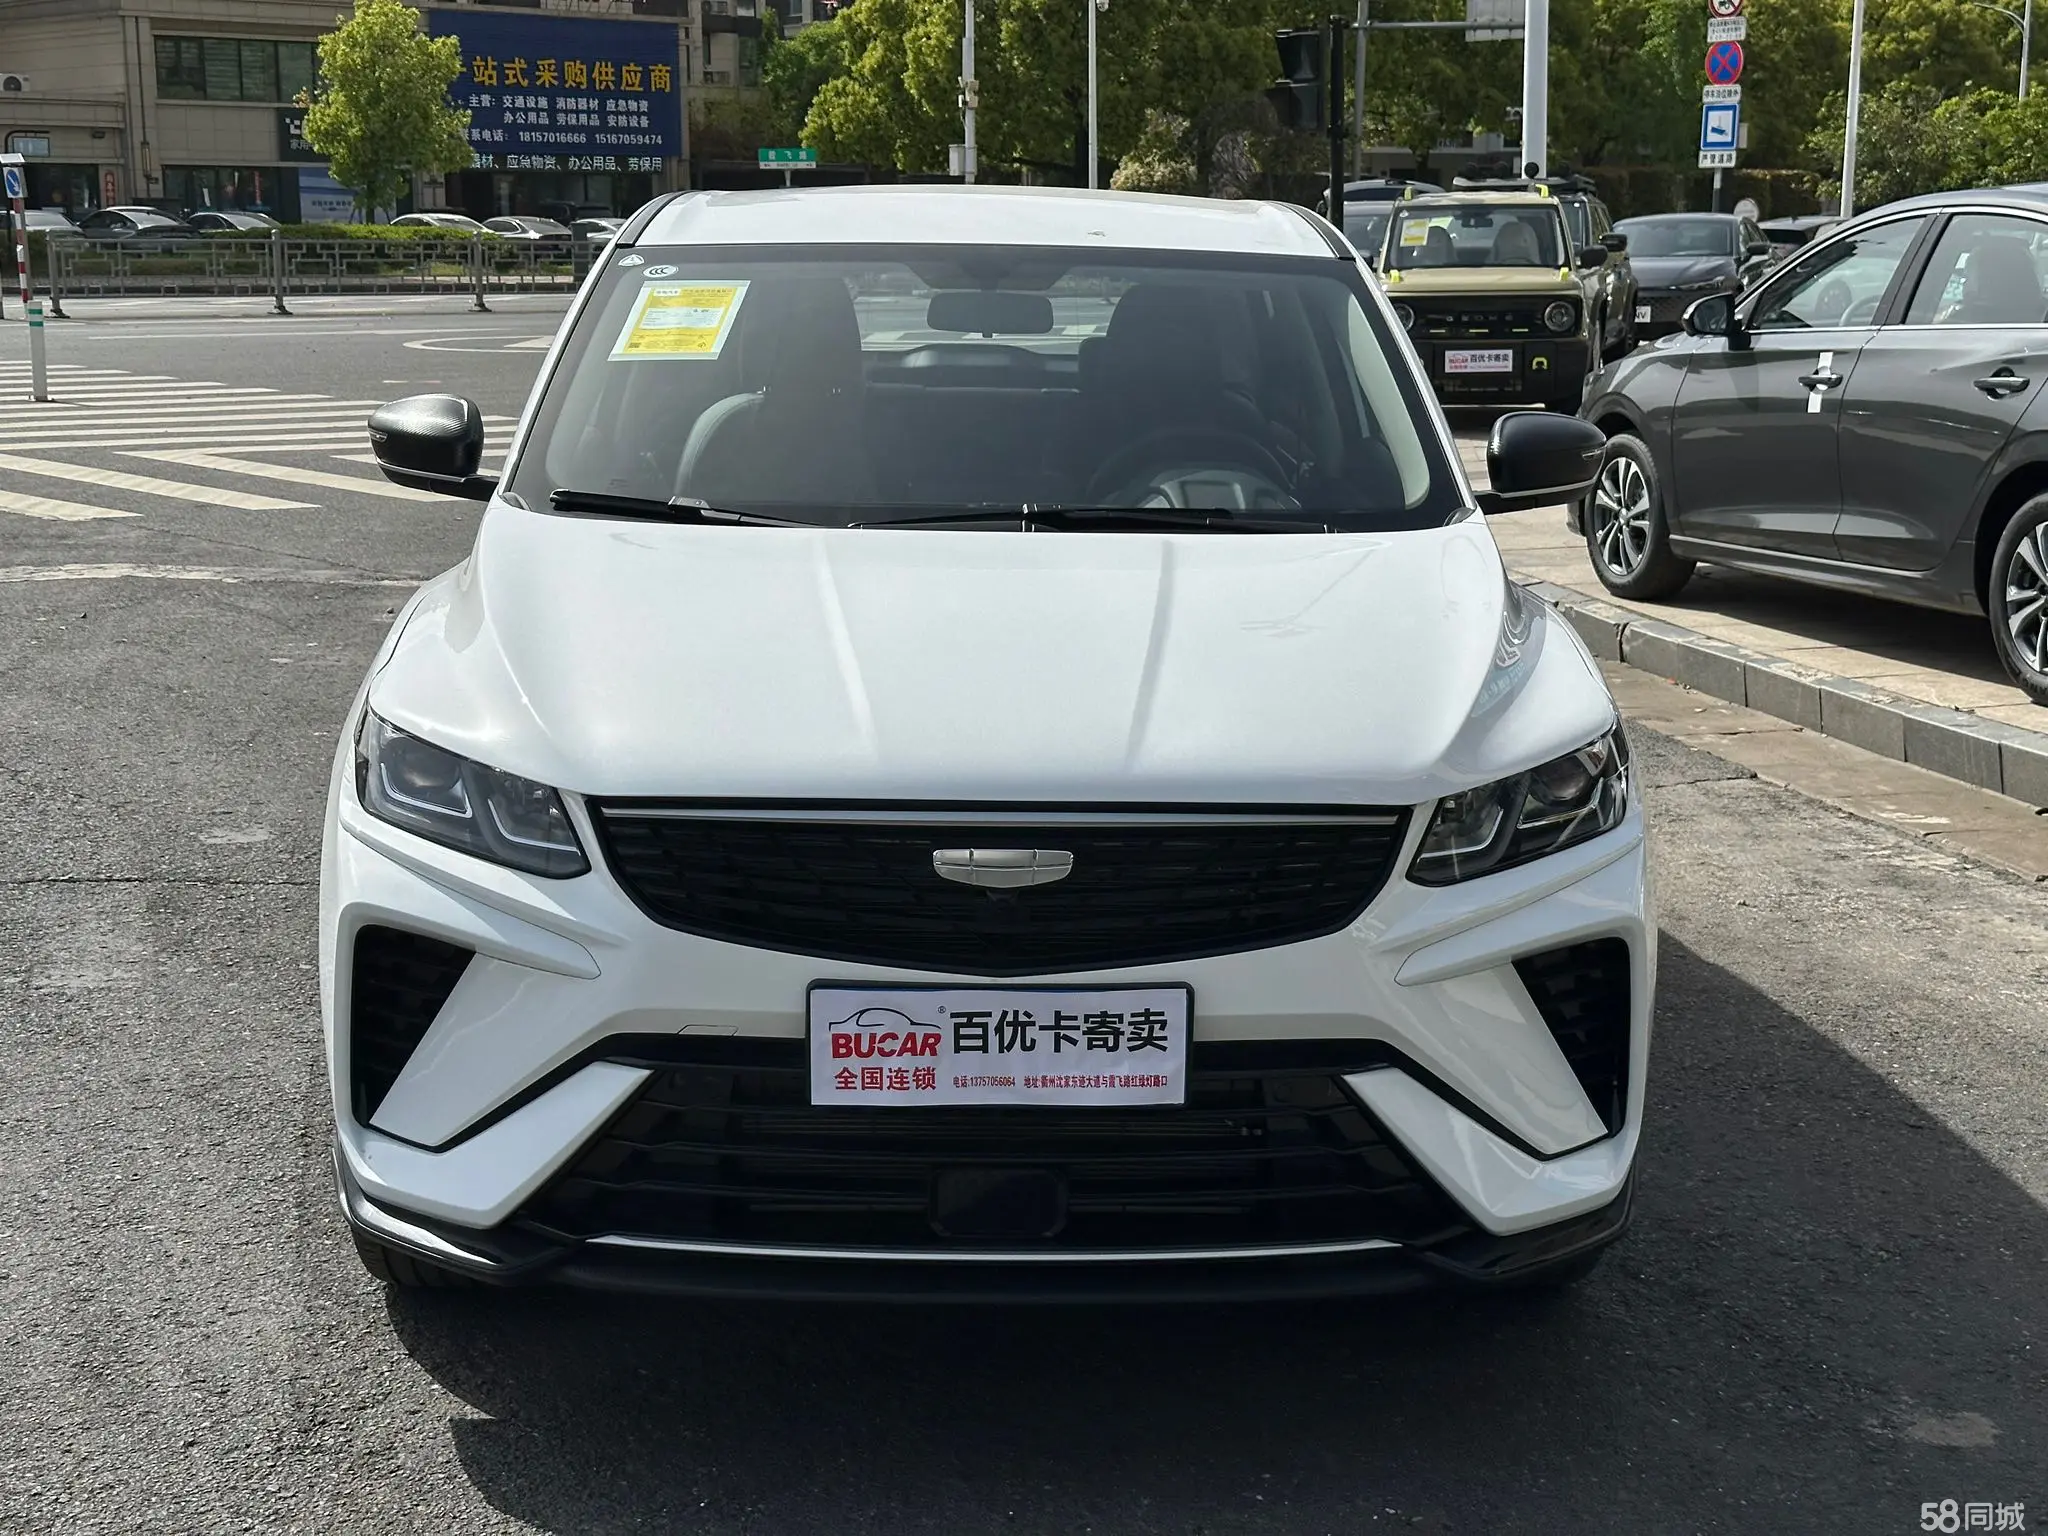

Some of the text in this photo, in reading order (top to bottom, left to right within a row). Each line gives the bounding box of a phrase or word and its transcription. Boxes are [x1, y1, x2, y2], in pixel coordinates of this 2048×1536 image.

[503, 95, 548, 109] 交通设施
[556, 98, 599, 111] 消防器材
[606, 99, 648, 112] 应急物资
[503, 112, 649, 128] 办公用品 劳保用品 安防设备
[519, 131, 587, 144] 18157016666
[595, 134, 662, 145] 15167059474
[950, 1008, 1168, 1054] 百优卡寄卖
[832, 1032, 942, 1058] BUCAR
[835, 1066, 937, 1091] 全国连锁
